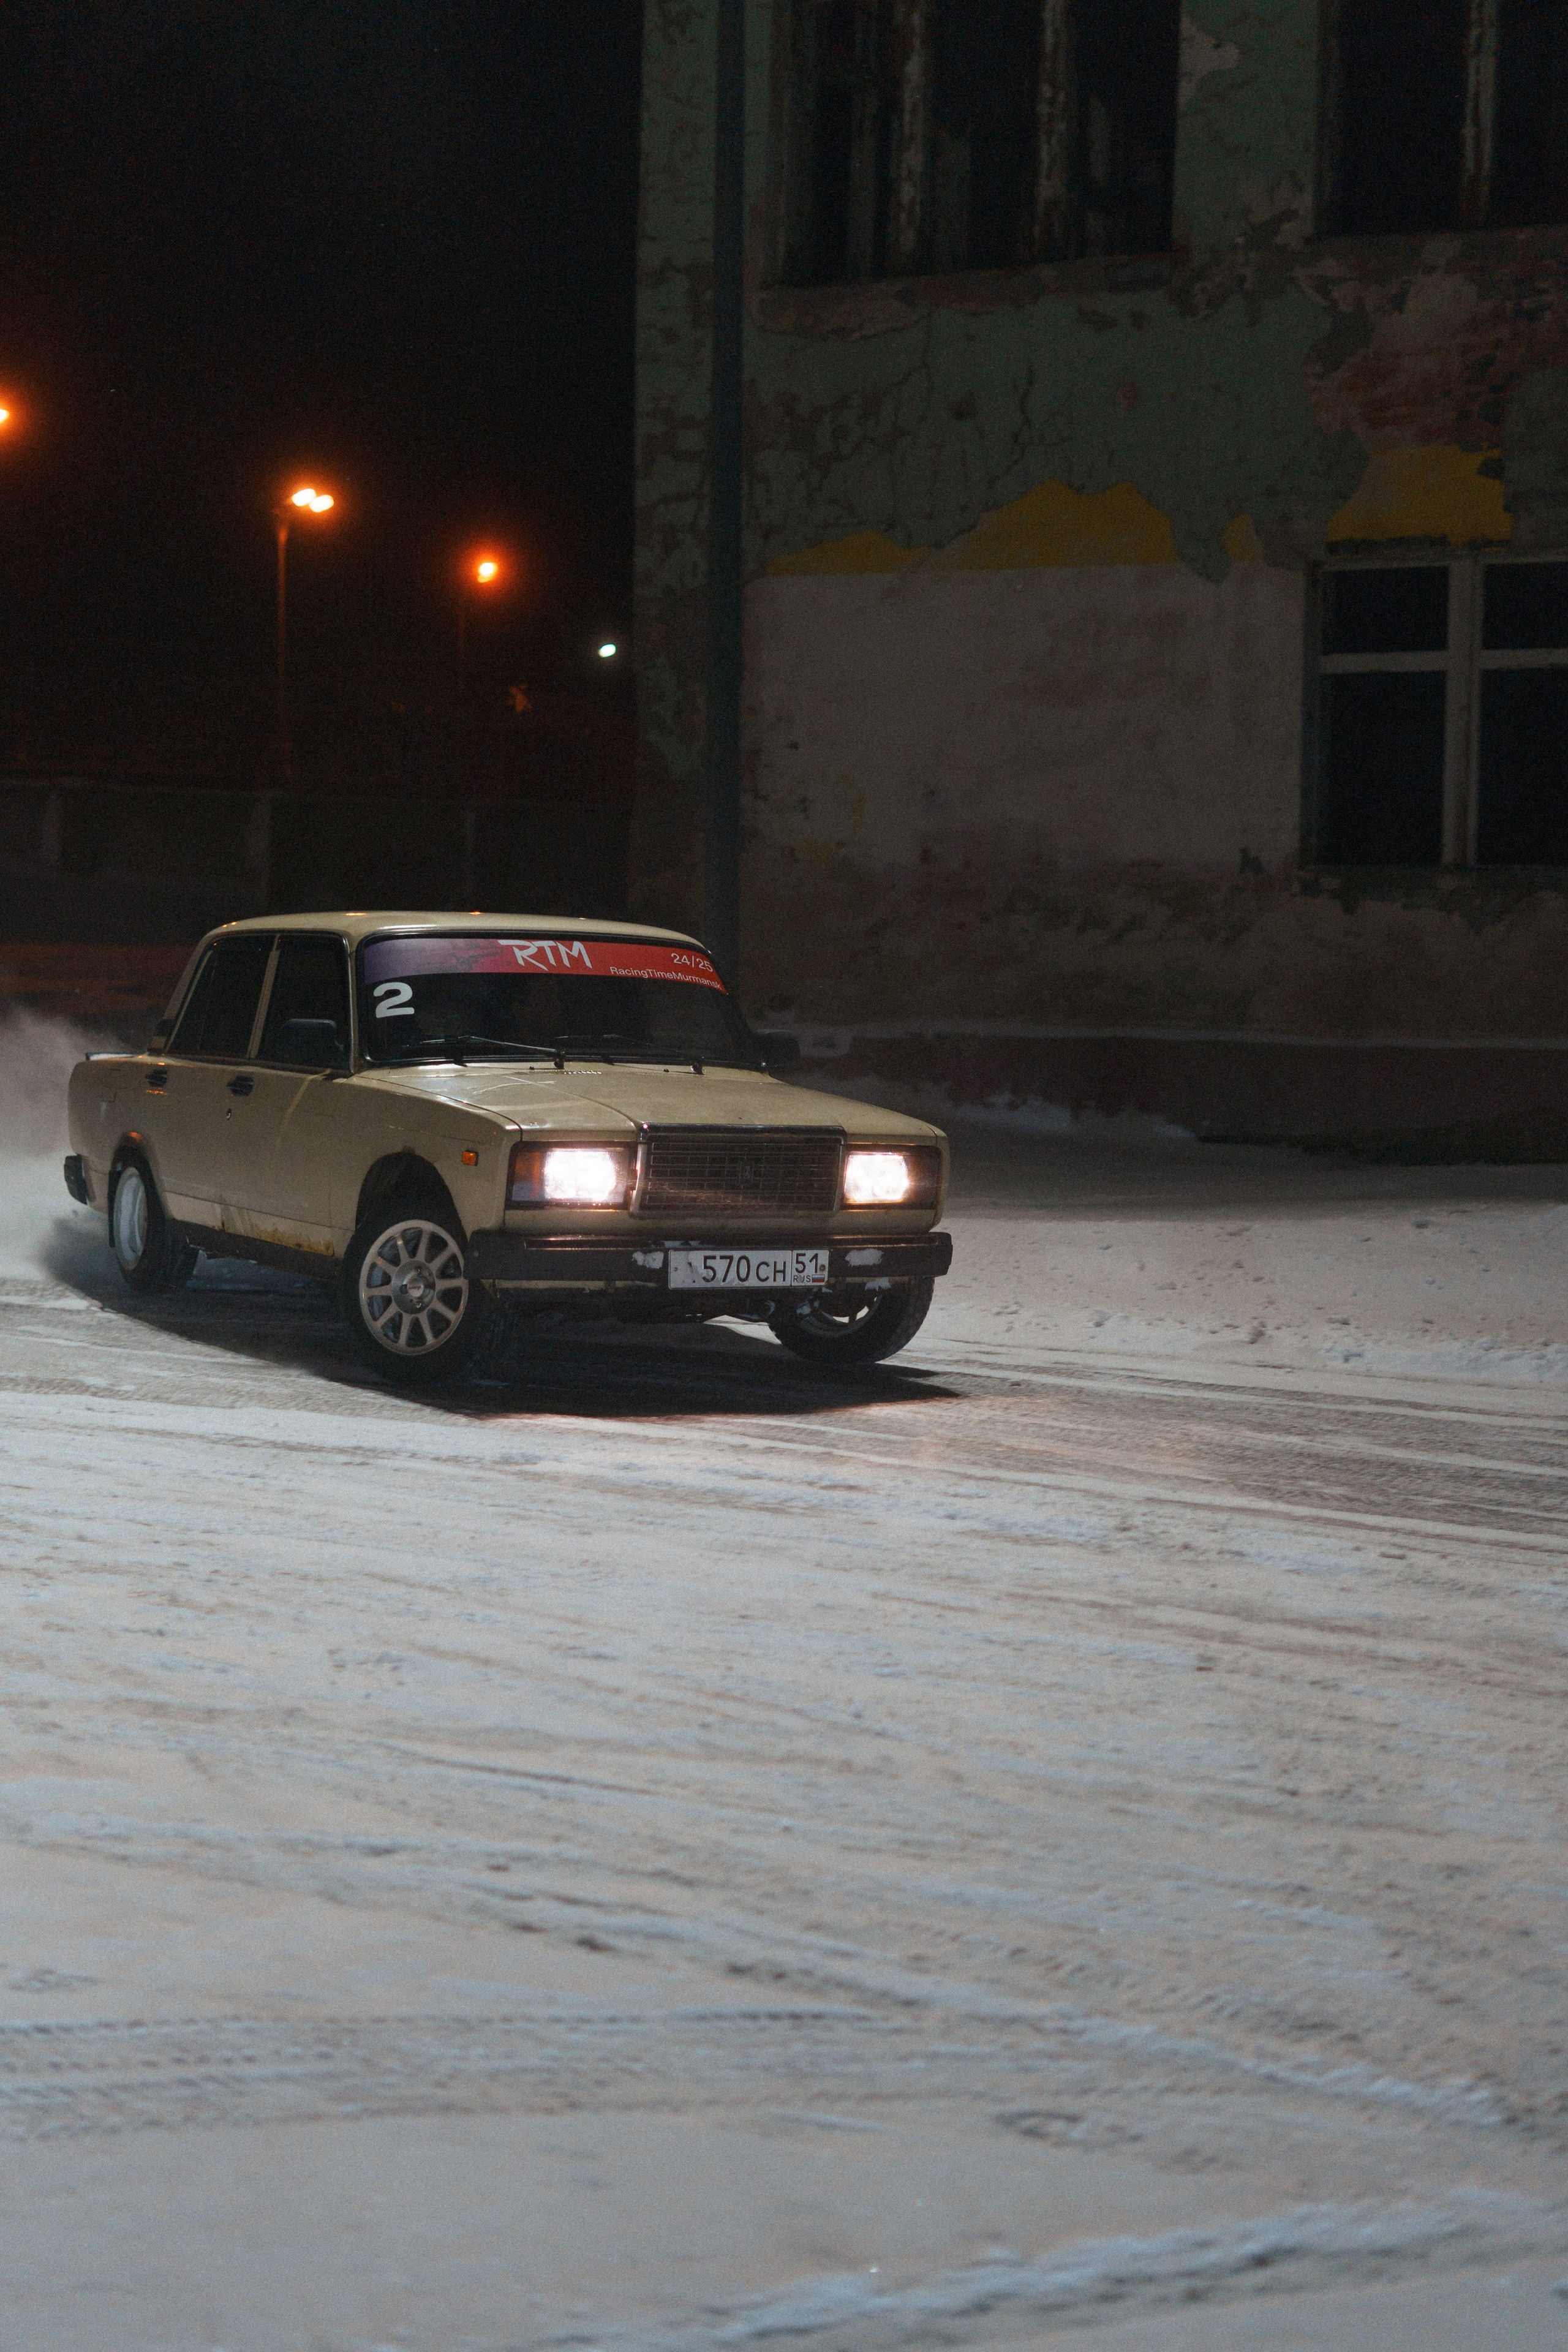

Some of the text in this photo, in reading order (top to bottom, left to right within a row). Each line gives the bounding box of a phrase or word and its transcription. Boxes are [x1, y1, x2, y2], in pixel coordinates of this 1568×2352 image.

[497, 940, 592, 971] RTM
[671, 953, 713, 973] 24/25
[609, 966, 722, 990] RacingTimeMurmansk
[373, 982, 415, 1018] 2
[795, 1253, 818, 1273] 51
